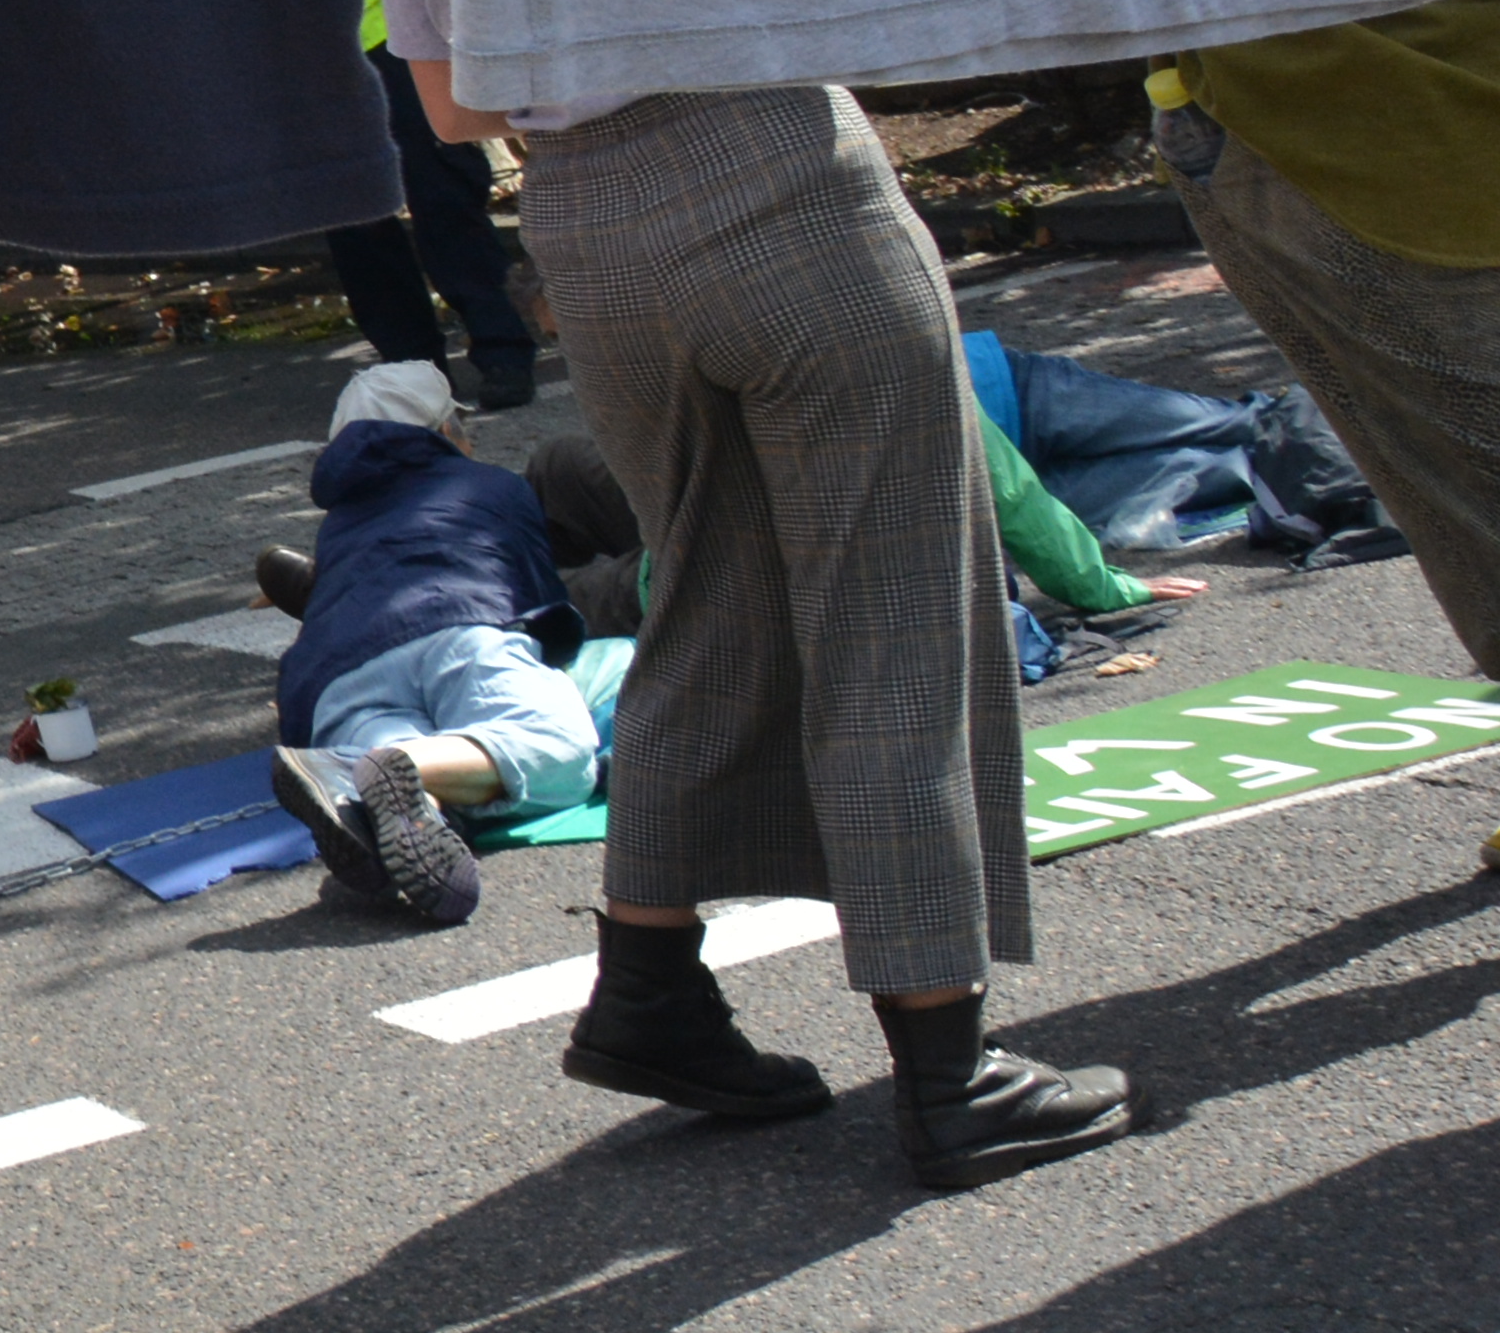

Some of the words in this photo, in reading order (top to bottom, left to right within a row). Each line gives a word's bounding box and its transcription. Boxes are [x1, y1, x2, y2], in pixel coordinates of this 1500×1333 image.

[1179, 678, 1399, 726] IN
[1307, 697, 1500, 752] NO
[1026, 754, 1319, 843] FAIT
